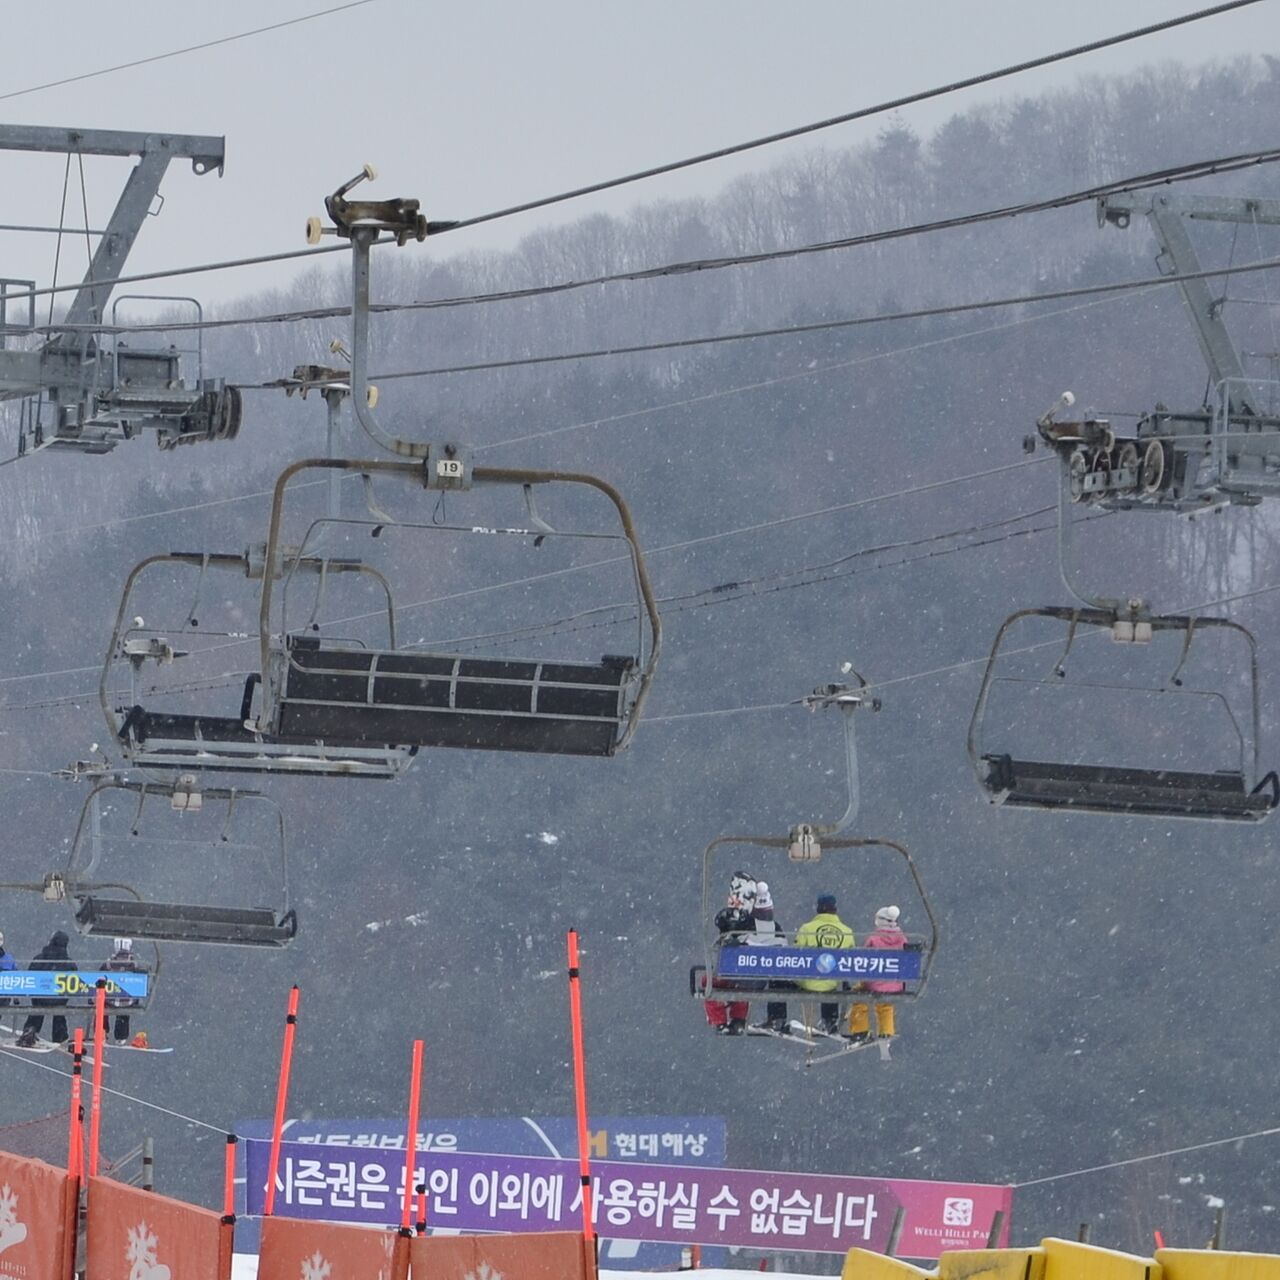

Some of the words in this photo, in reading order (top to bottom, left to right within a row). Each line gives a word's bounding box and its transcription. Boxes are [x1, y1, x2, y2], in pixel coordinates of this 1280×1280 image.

[443, 462, 459, 473] 19
[737, 954, 758, 967] BIG
[760, 955, 773, 968] to
[775, 956, 813, 969] GREAT
[838, 956, 900, 973] 신한카드
[614, 1131, 708, 1157] 현대해상
[263, 1157, 390, 1210] 시즌권은
[469, 1170, 563, 1222] 이외에
[569, 1176, 699, 1230] 사용하실
[706, 1184, 741, 1232] 수
[749, 1188, 878, 1240] 없습니다
[945, 1228, 971, 1239] HILLI
